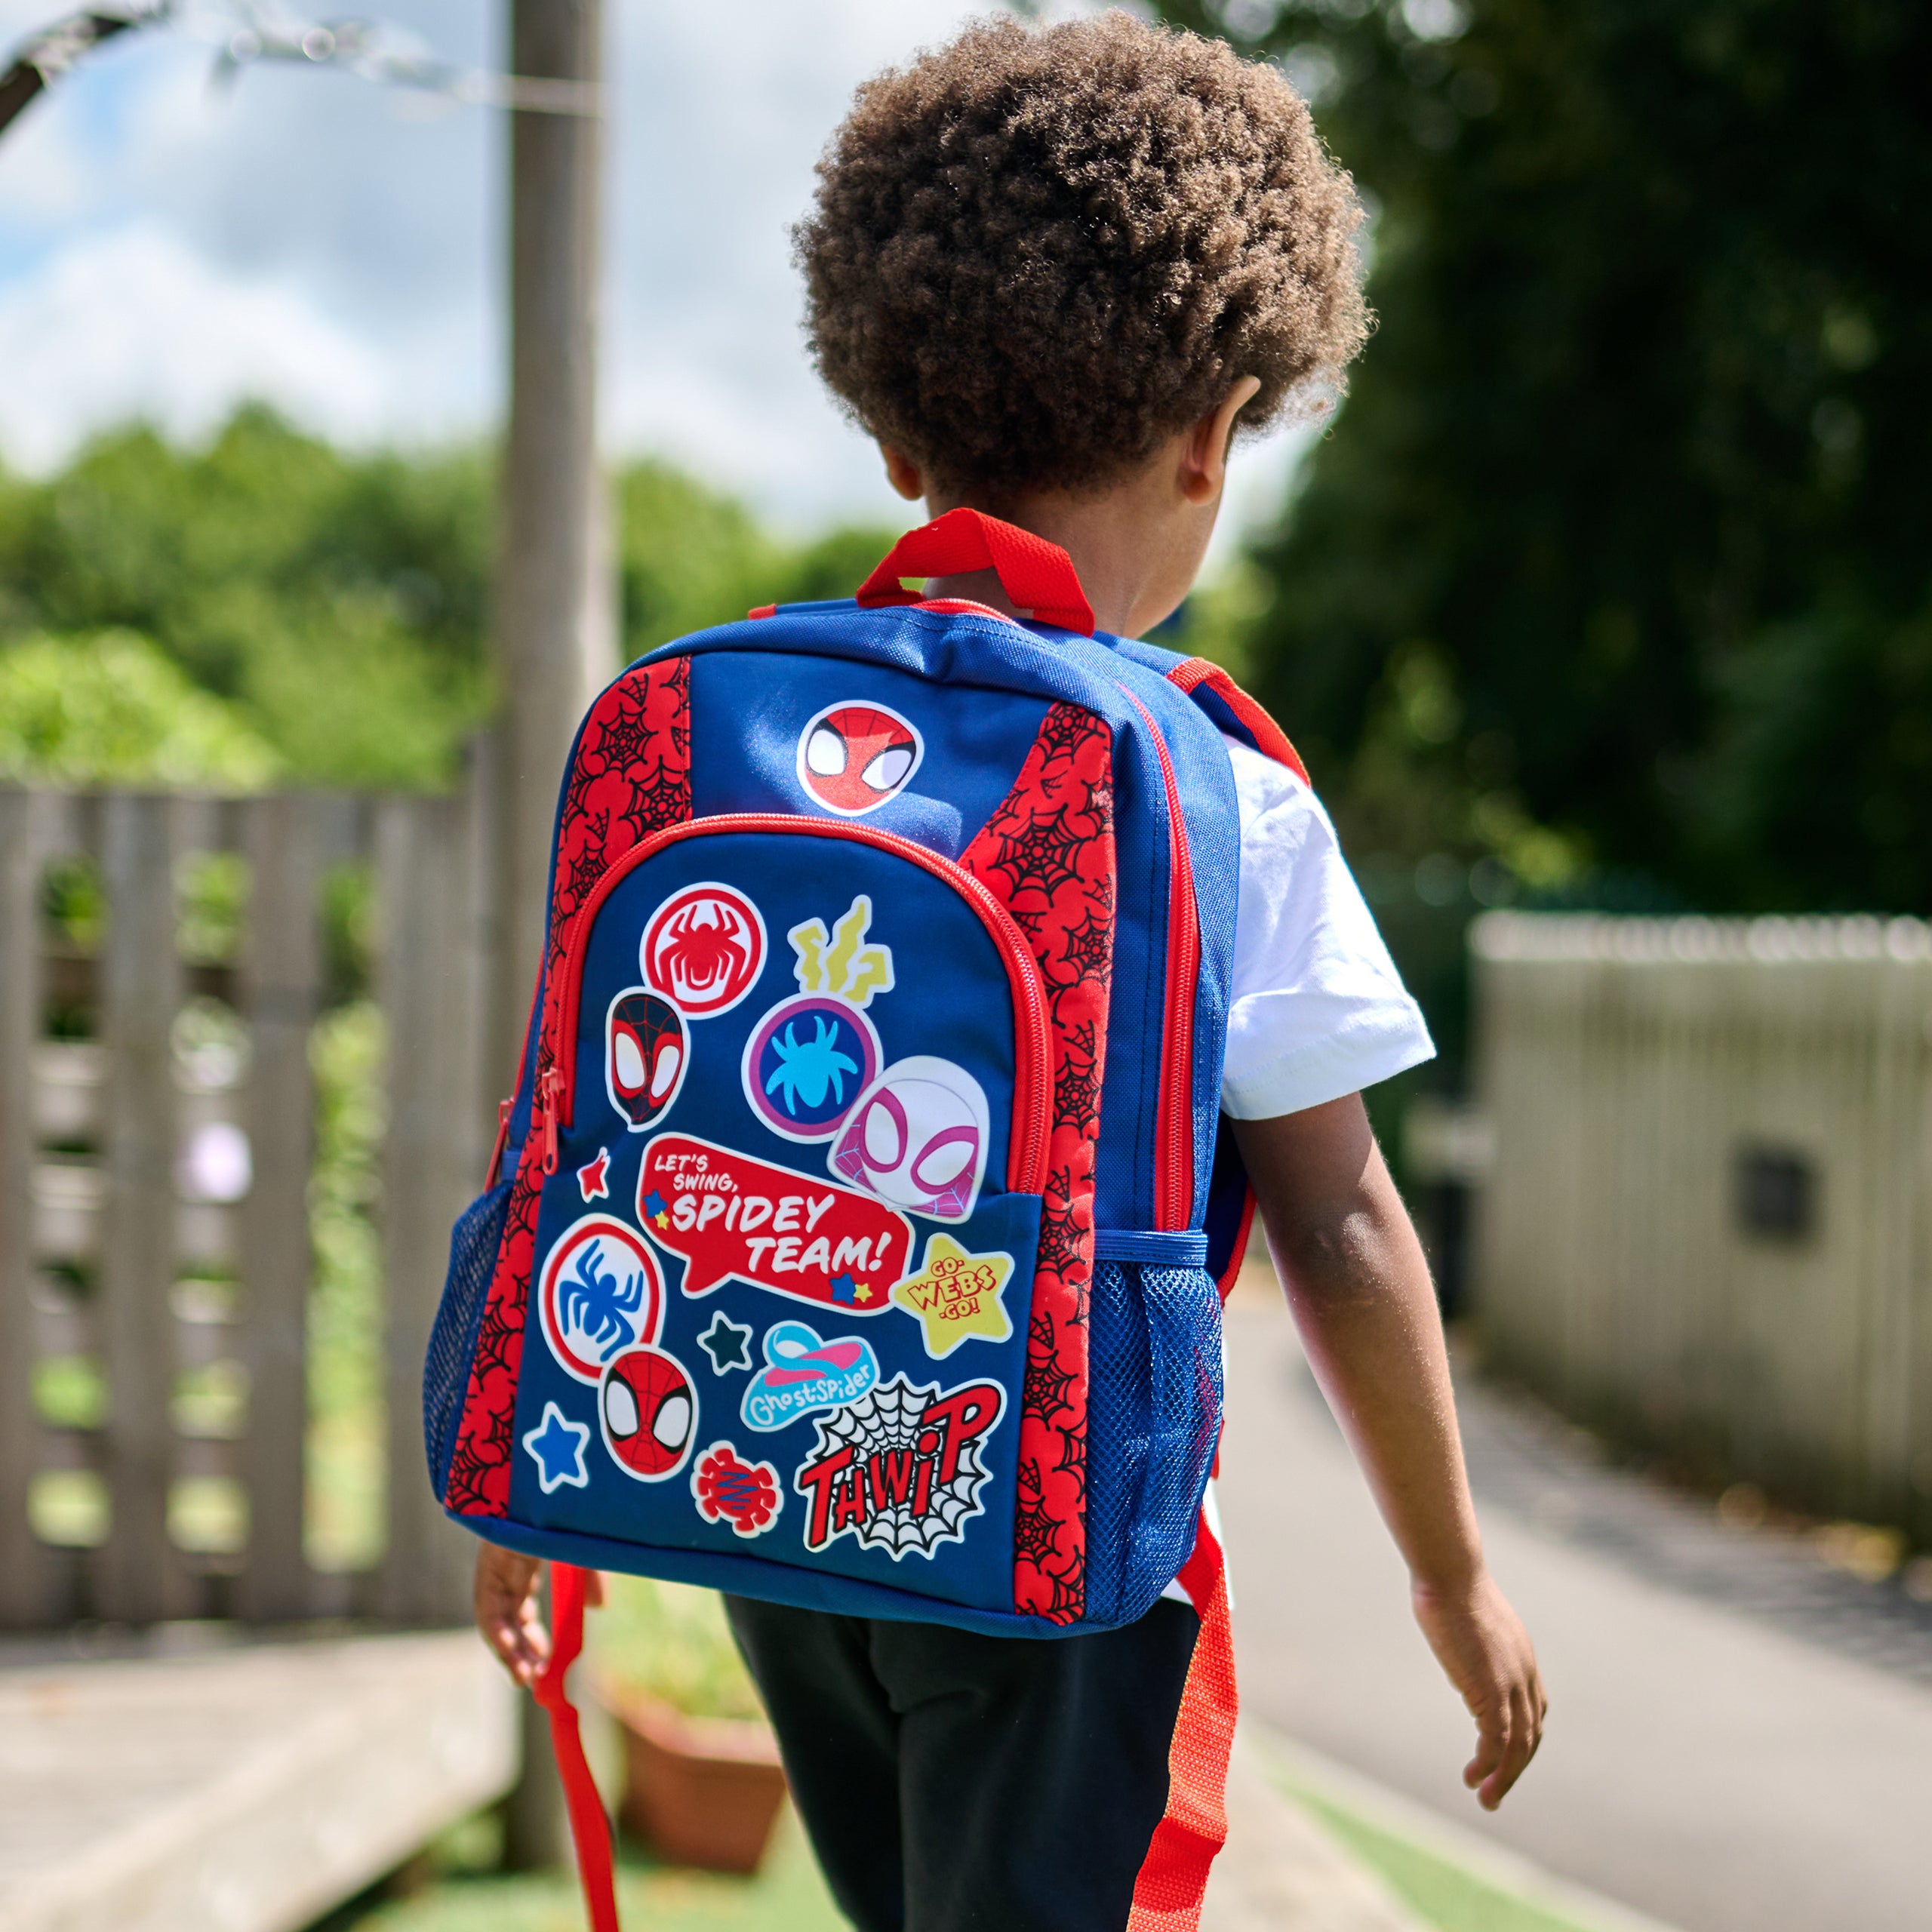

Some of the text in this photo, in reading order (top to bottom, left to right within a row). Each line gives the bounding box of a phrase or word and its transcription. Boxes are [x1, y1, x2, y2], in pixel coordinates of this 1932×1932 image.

[654, 1154, 708, 1172] LET'S
[672, 1172, 738, 1193] SWING,
[671, 1193, 835, 1234] SPIDEY
[745, 1232, 892, 1274] TEAM!
[907, 1264, 997, 1311] WEBS
